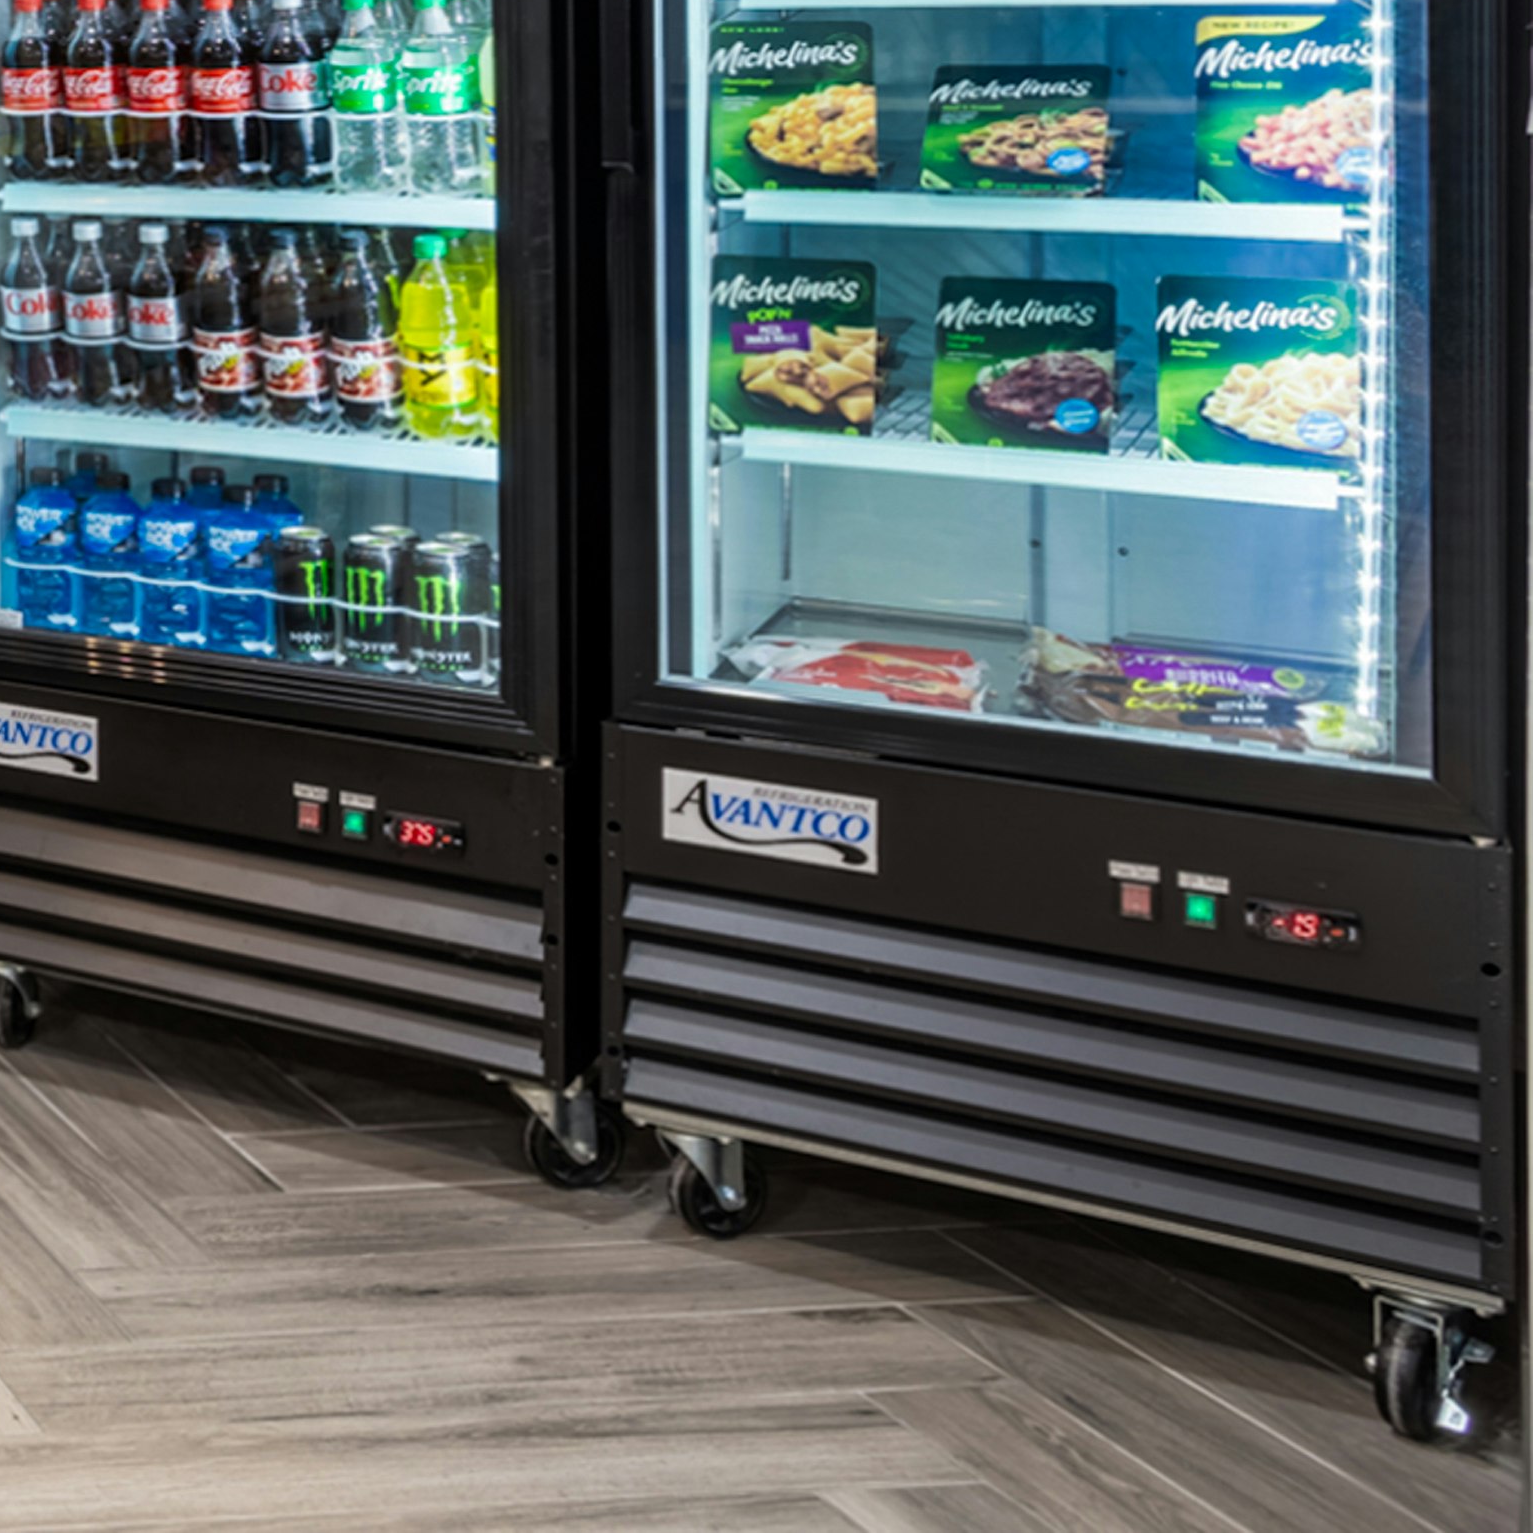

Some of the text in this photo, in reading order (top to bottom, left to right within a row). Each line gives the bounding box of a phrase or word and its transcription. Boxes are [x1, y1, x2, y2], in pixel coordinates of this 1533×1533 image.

[708, 37, 859, 76] Michelina's
[1194, 38, 1373, 78] Michelina's
[929, 75, 1093, 105] Michelina's
[709, 272, 859, 308] Michelina's
[934, 296, 1098, 330] Michelina's
[1156, 296, 1339, 336] Michelina's
[671, 779, 871, 846] AVANTCO
[752, 785, 871, 814] REFRIGERATION
